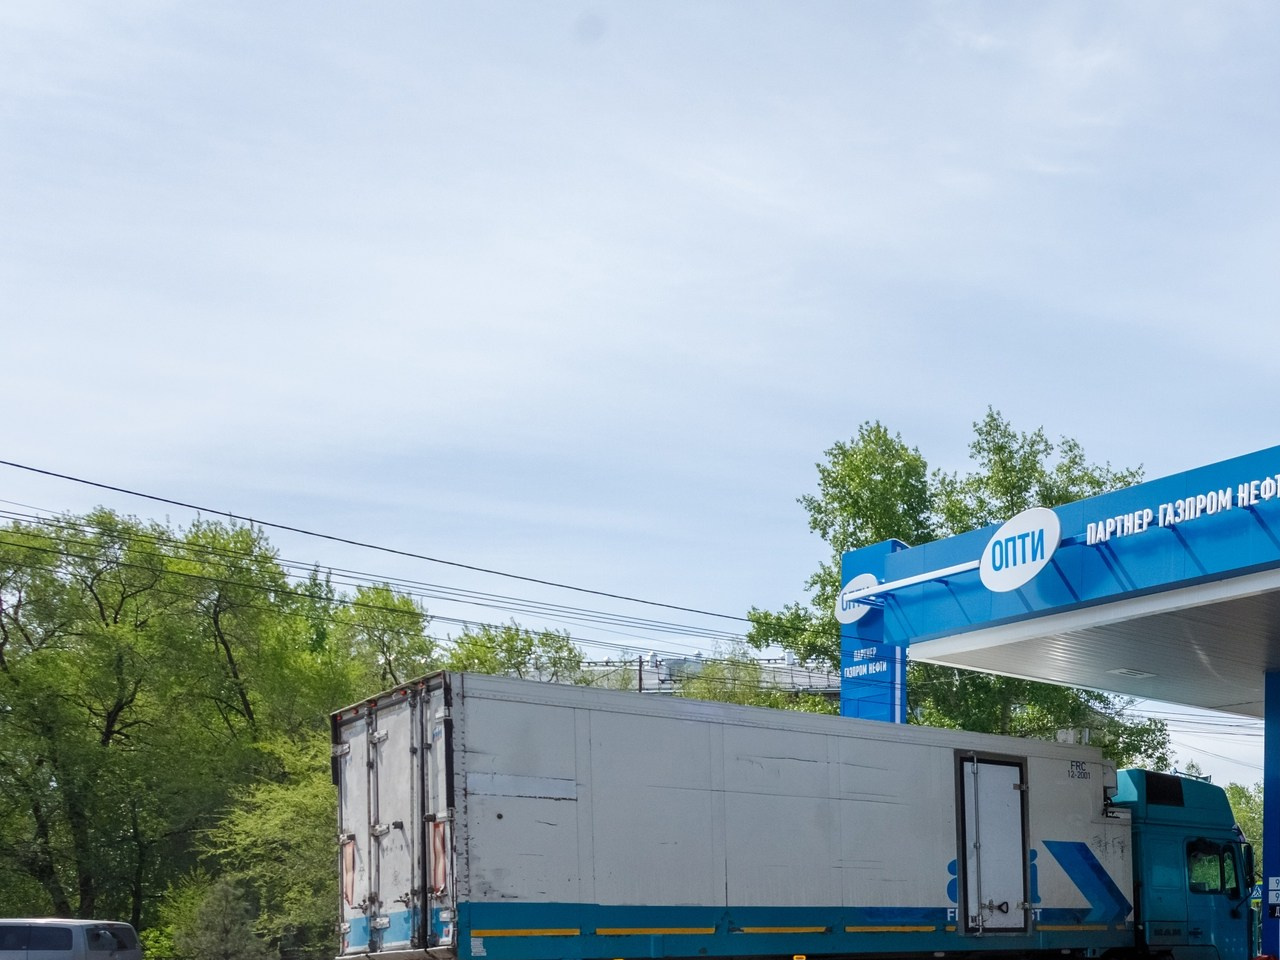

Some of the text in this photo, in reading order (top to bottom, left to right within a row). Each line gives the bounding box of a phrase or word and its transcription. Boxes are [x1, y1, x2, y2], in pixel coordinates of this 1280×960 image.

[1086, 508, 1153, 545] ПАРТНЕР
[1158, 487, 1233, 528] ГАЗПРОМ
[991, 528, 1045, 572] ОПТИ
[843, 660, 887, 678] ГАЗПРОМ НЕФТИ
[1067, 769, 1091, 780] 12-2001
[1070, 760, 1087, 772] FRC
